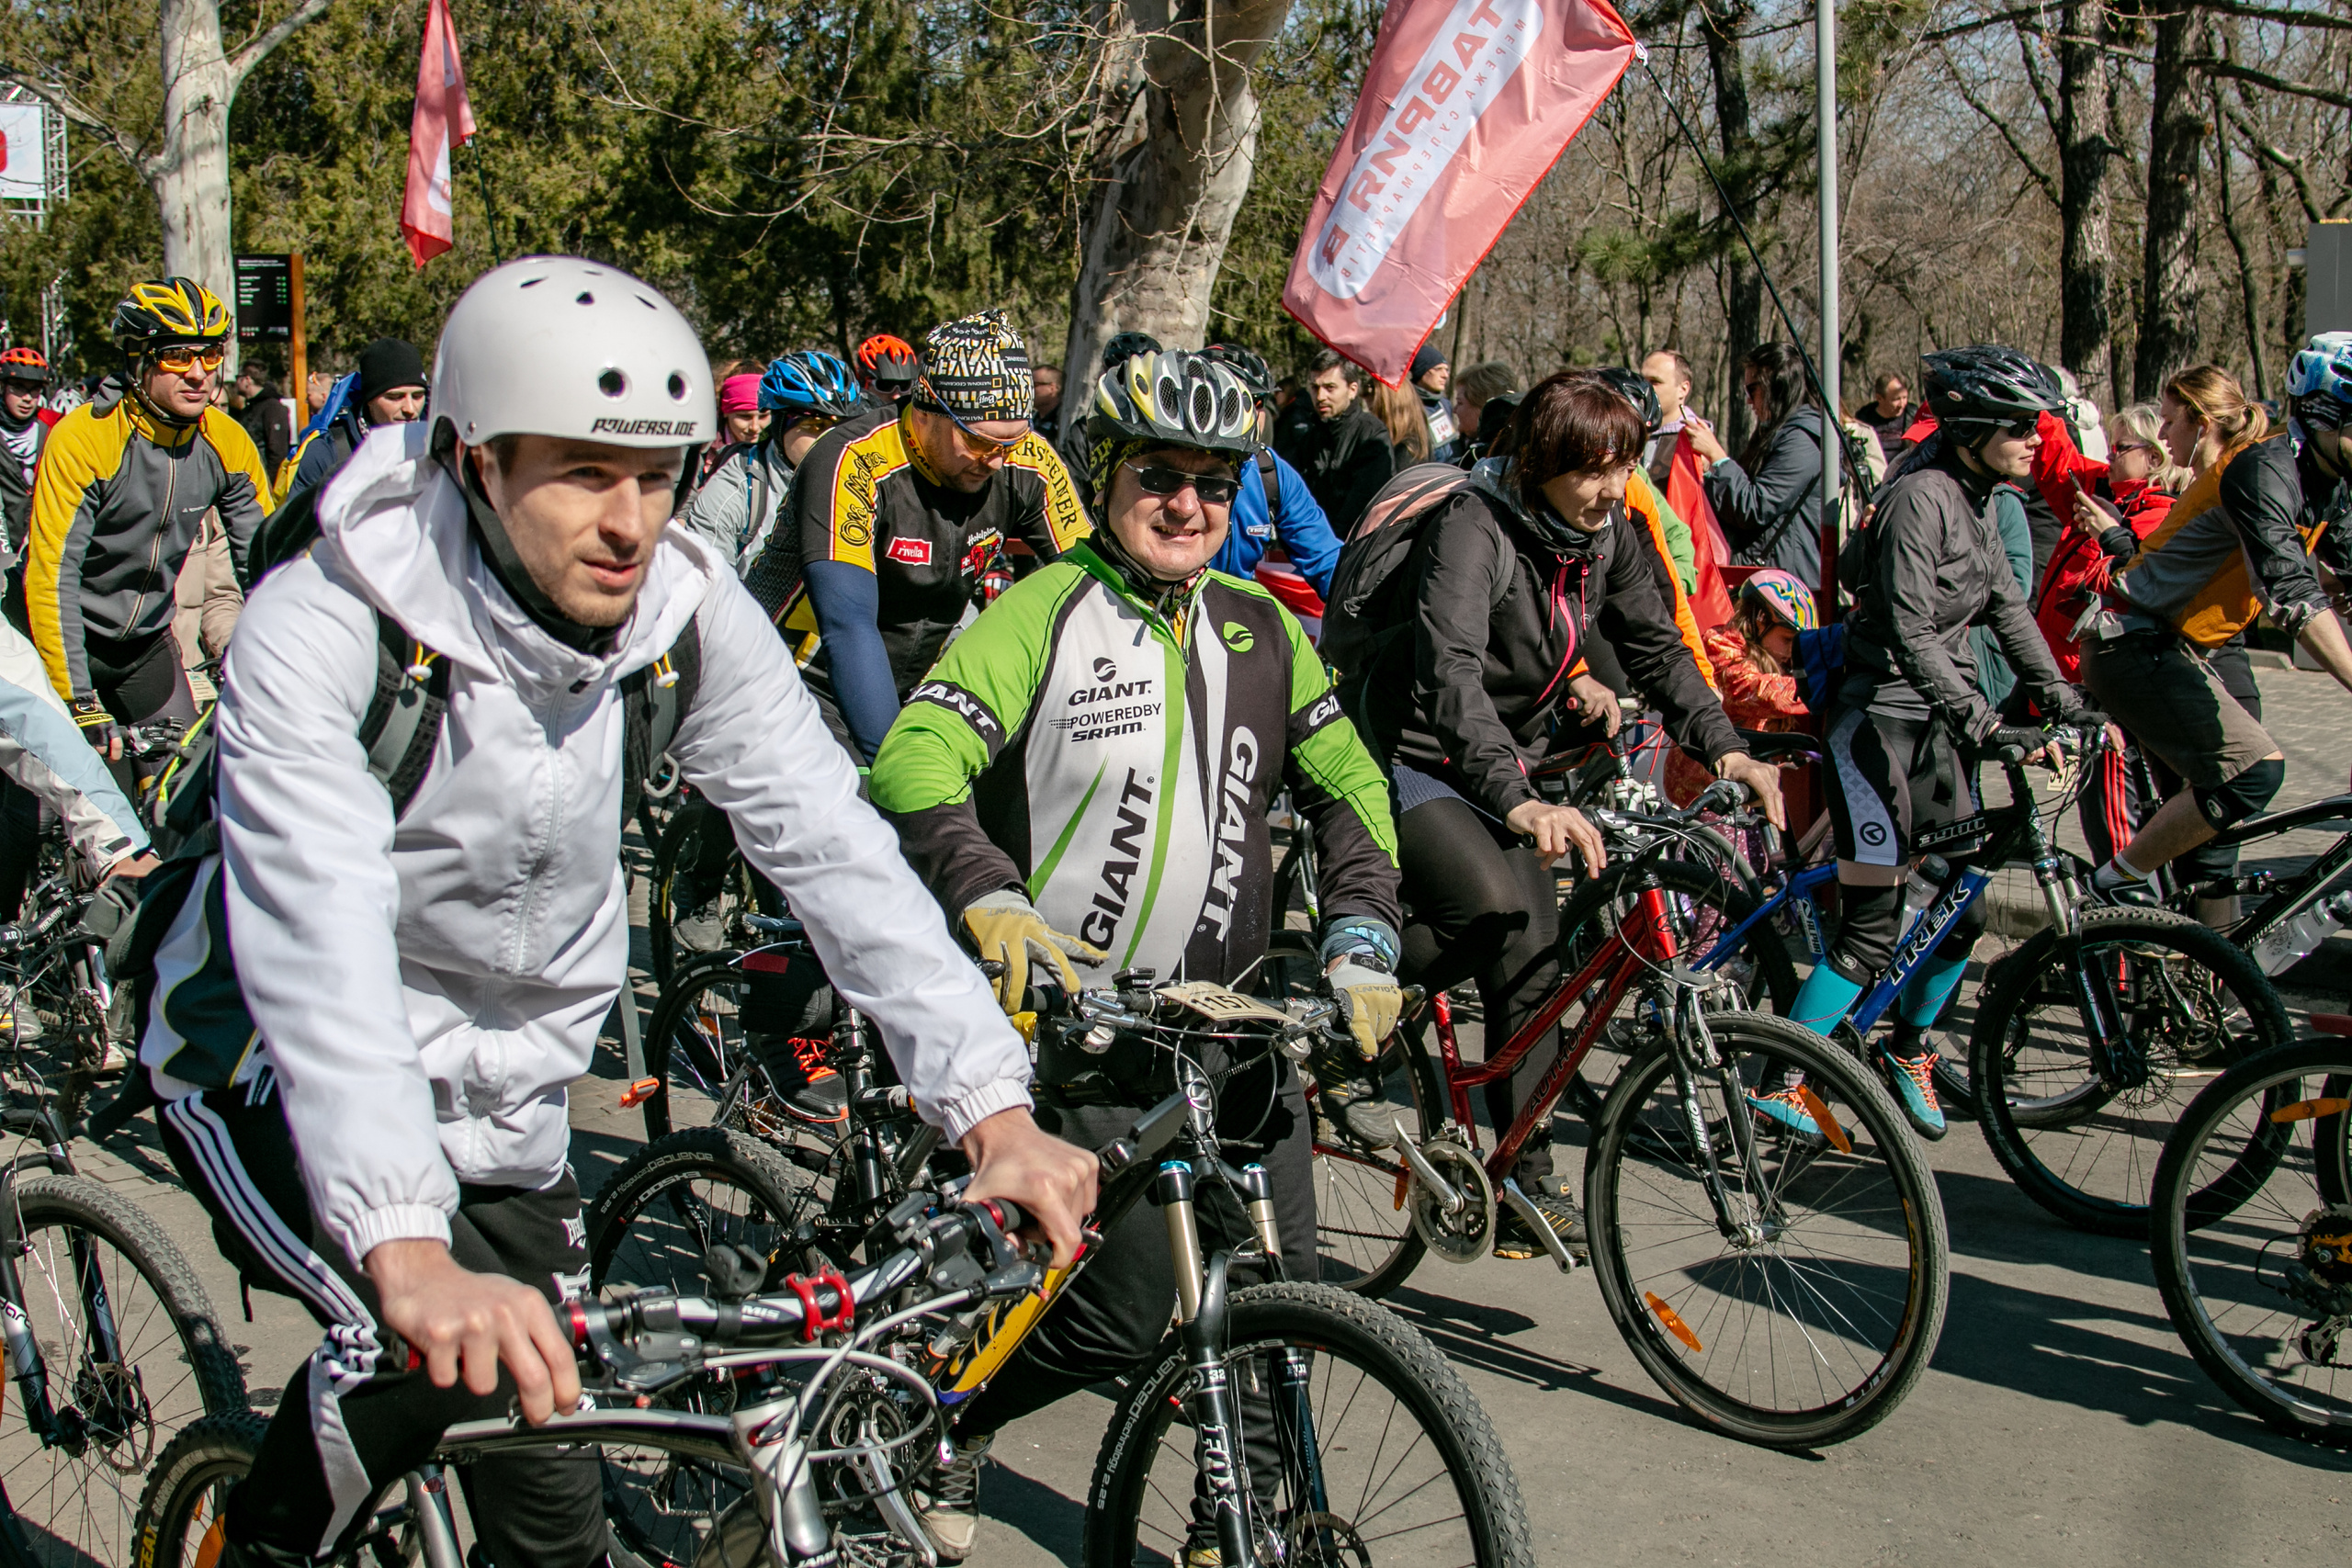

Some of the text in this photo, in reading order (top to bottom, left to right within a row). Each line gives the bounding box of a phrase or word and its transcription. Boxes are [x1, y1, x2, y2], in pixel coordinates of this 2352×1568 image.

[591, 418, 698, 436] POWERSLIDE
[897, 545, 924, 558] rivella
[5, 931, 18, 941] XR
[1884, 878, 1971, 986] TREK
[1529, 1012, 1593, 1118] AUTHOR
[600, 1190, 618, 1213] 2.25
[1208, 1368, 1227, 1381] 32
[1106, 1416, 1139, 1474] technology
[1198, 1423, 1241, 1517] FOX
[1096, 1472, 1112, 1510] 2.25
